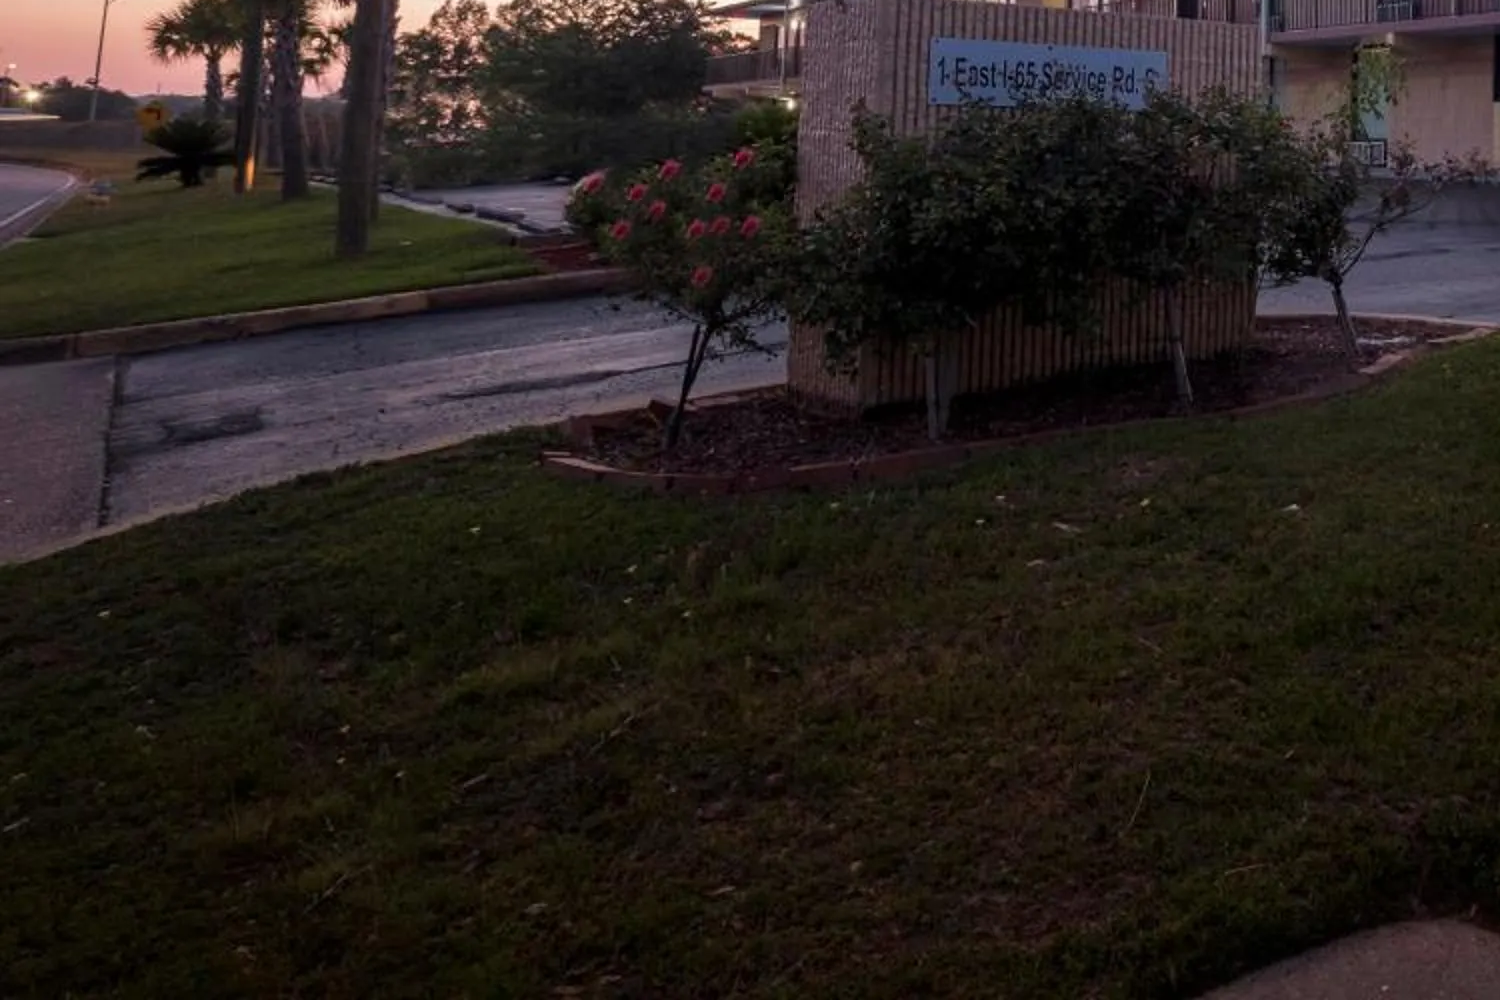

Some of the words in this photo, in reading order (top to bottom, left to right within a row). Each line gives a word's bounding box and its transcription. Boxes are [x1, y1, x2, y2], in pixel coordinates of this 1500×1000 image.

[955, 57, 998, 89] East
[1003, 60, 1036, 89] I-65
[1042, 61, 1107, 93] Service
[1111, 65, 1140, 95] Rd.
